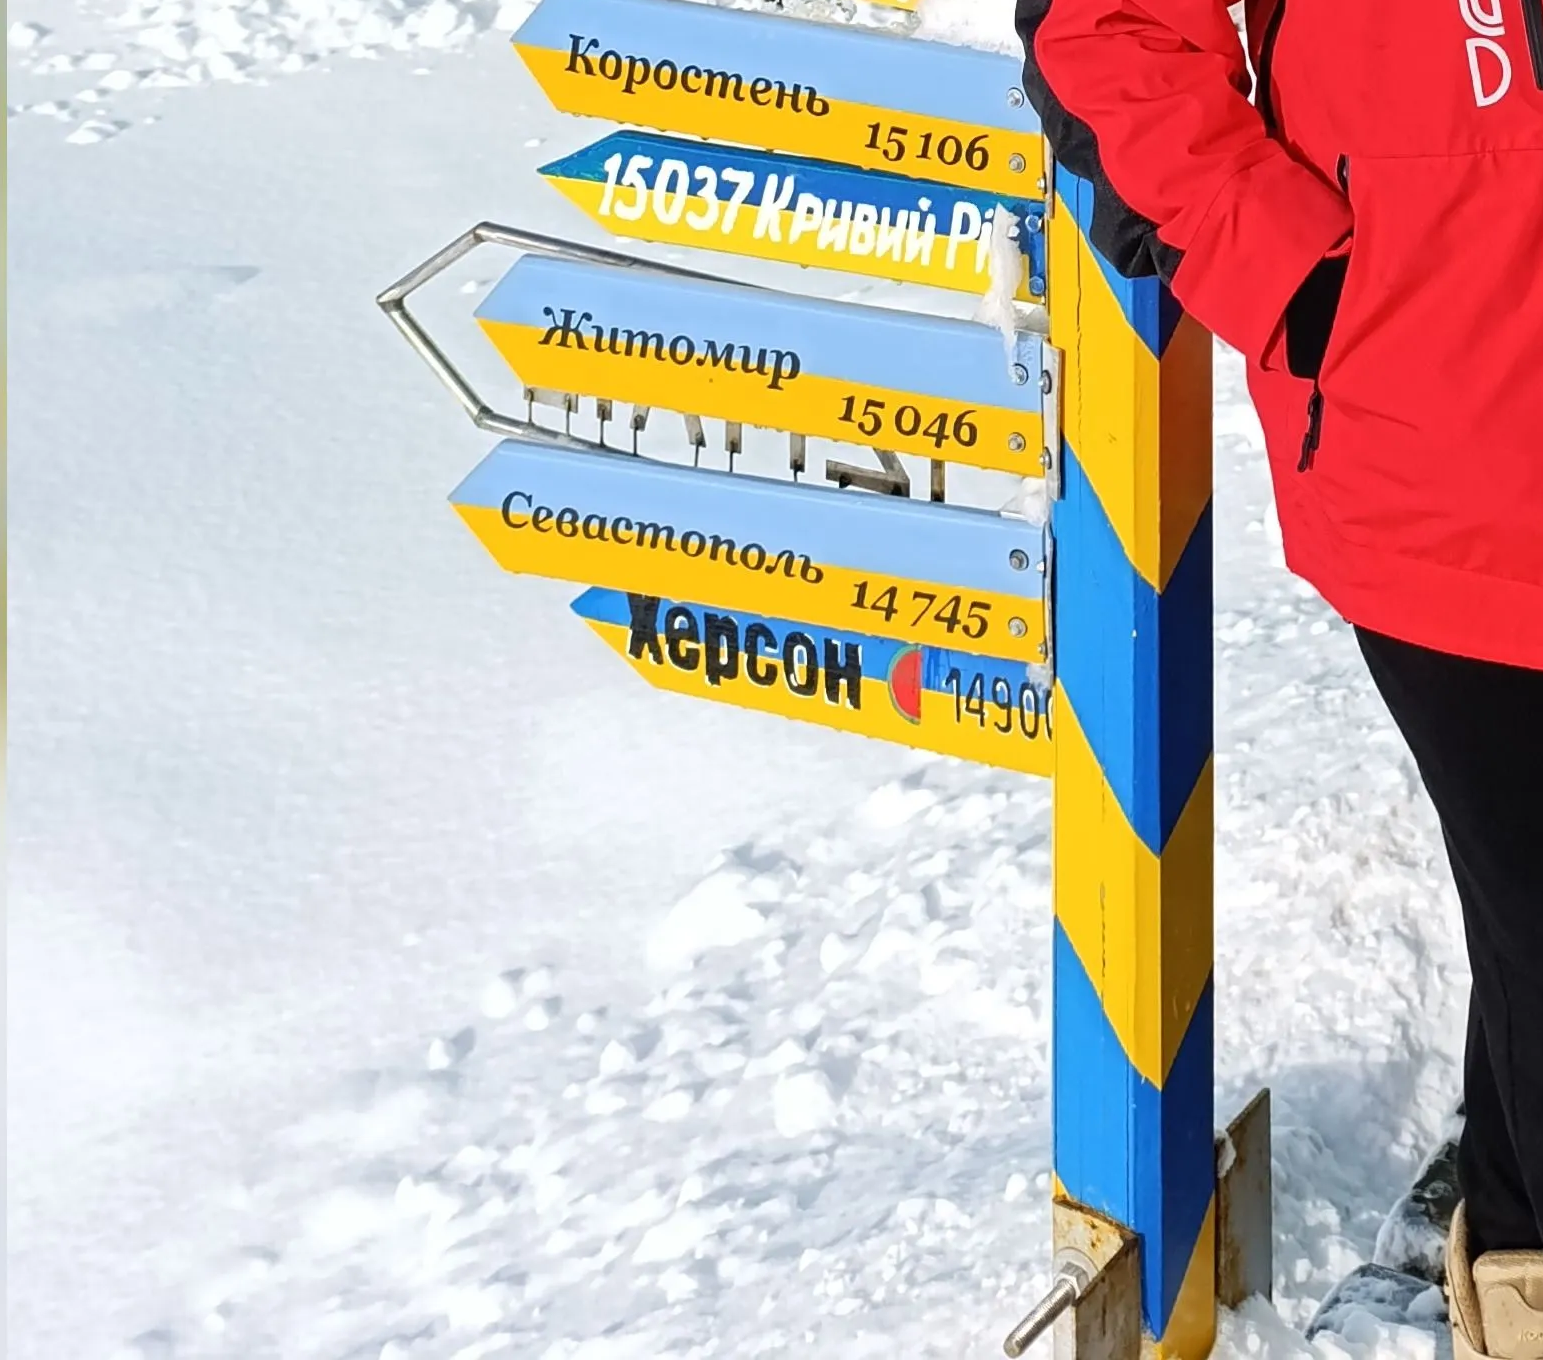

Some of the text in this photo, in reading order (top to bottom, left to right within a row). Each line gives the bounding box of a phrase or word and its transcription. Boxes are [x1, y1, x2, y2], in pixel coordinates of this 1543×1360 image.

[566, 34, 831, 119] Коростень
[598, 152, 1019, 275] 15037 Кривий Рі
[538, 306, 801, 390] Житомир
[500, 491, 825, 586] Севастополь
[625, 591, 865, 711] Херсон
